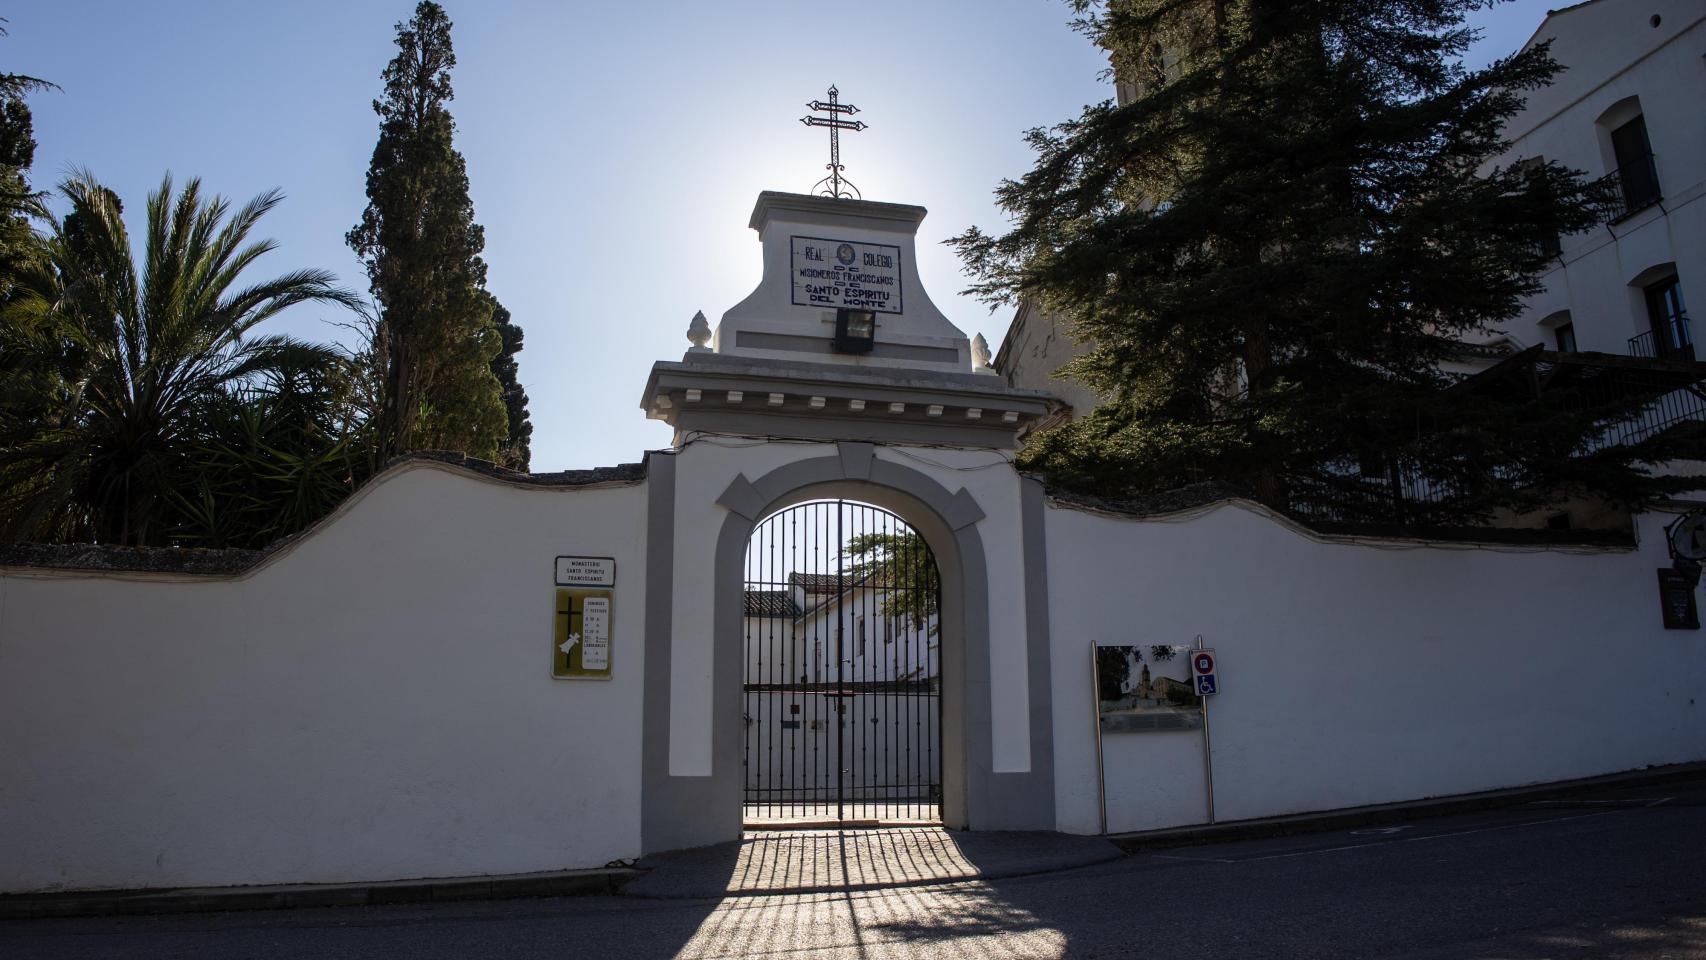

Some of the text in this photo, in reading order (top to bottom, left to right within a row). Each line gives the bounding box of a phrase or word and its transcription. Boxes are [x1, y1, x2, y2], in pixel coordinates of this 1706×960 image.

[805, 247, 893, 268] REAL COLEGIO
[800, 268, 894, 285] MISIONEROS FRANCISCANOS
[805, 284, 889, 300] SANTO ESPIRITU
[810, 295, 886, 308] DEL MONTE
